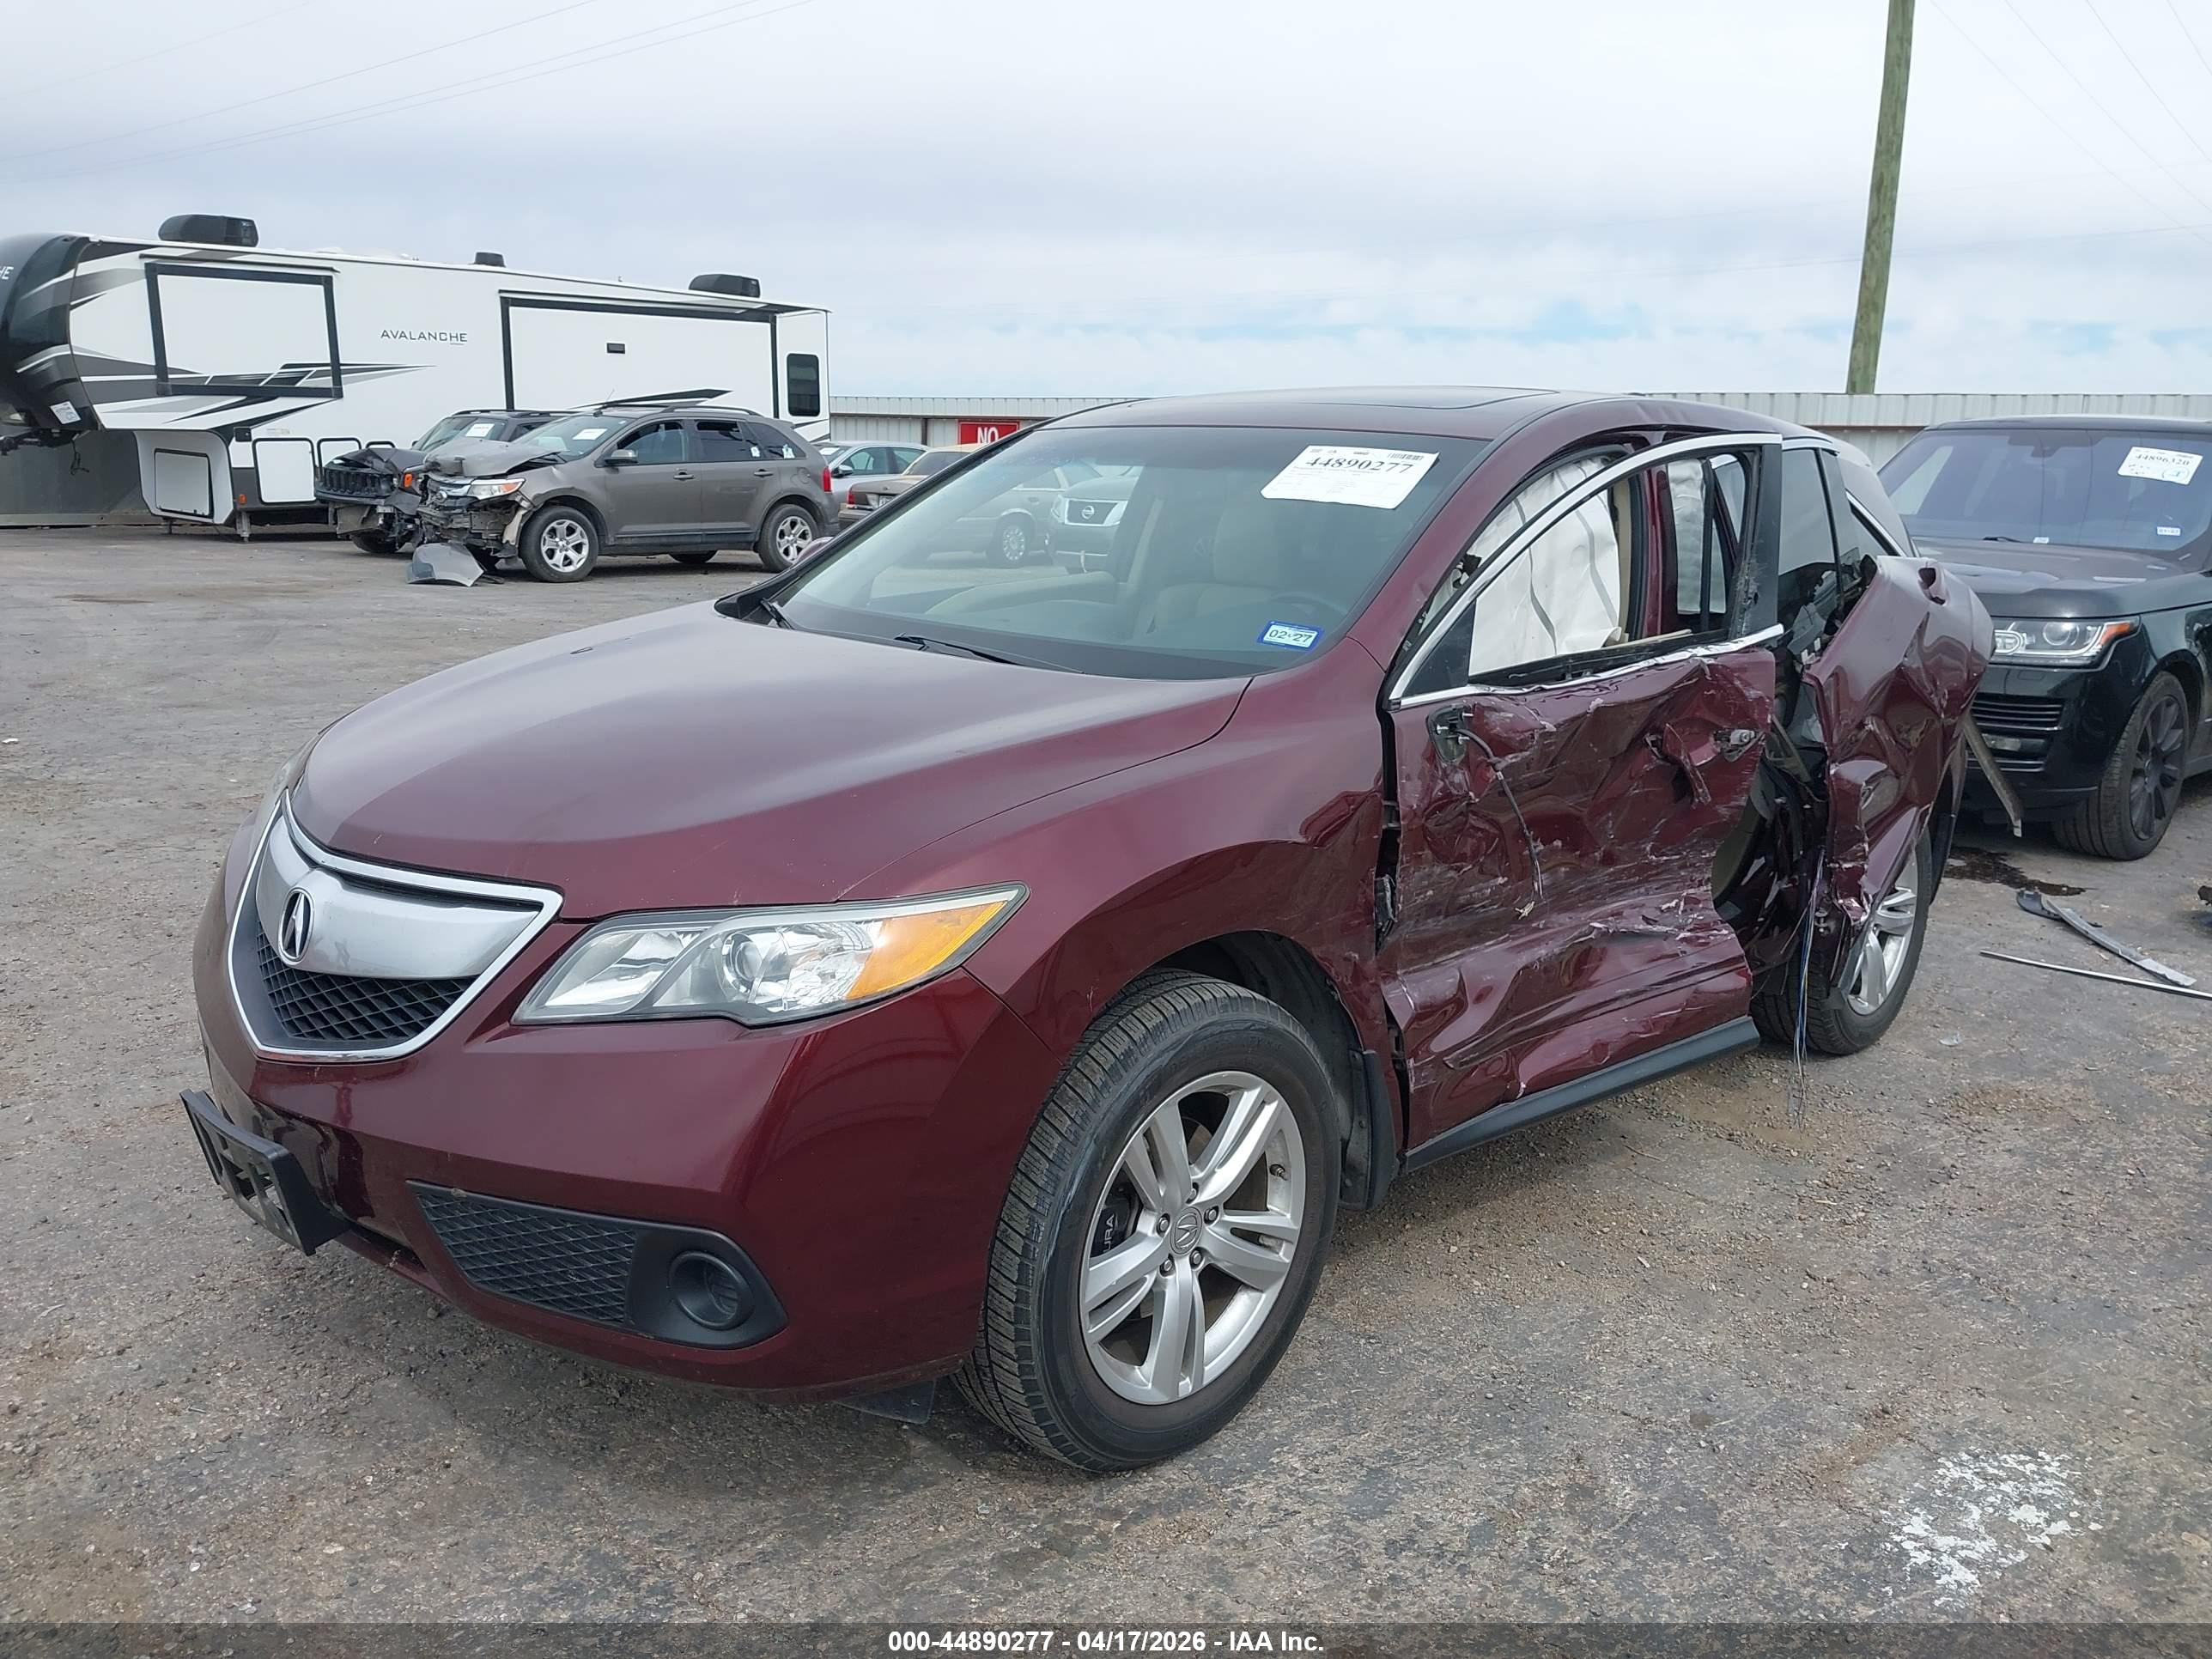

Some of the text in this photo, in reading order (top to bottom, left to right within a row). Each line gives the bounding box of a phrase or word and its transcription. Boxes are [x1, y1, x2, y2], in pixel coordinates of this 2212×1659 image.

[380, 330, 468, 342] AVALANCHE
[977, 426, 1000, 445] NO
[1305, 456, 1414, 474] 44890277
